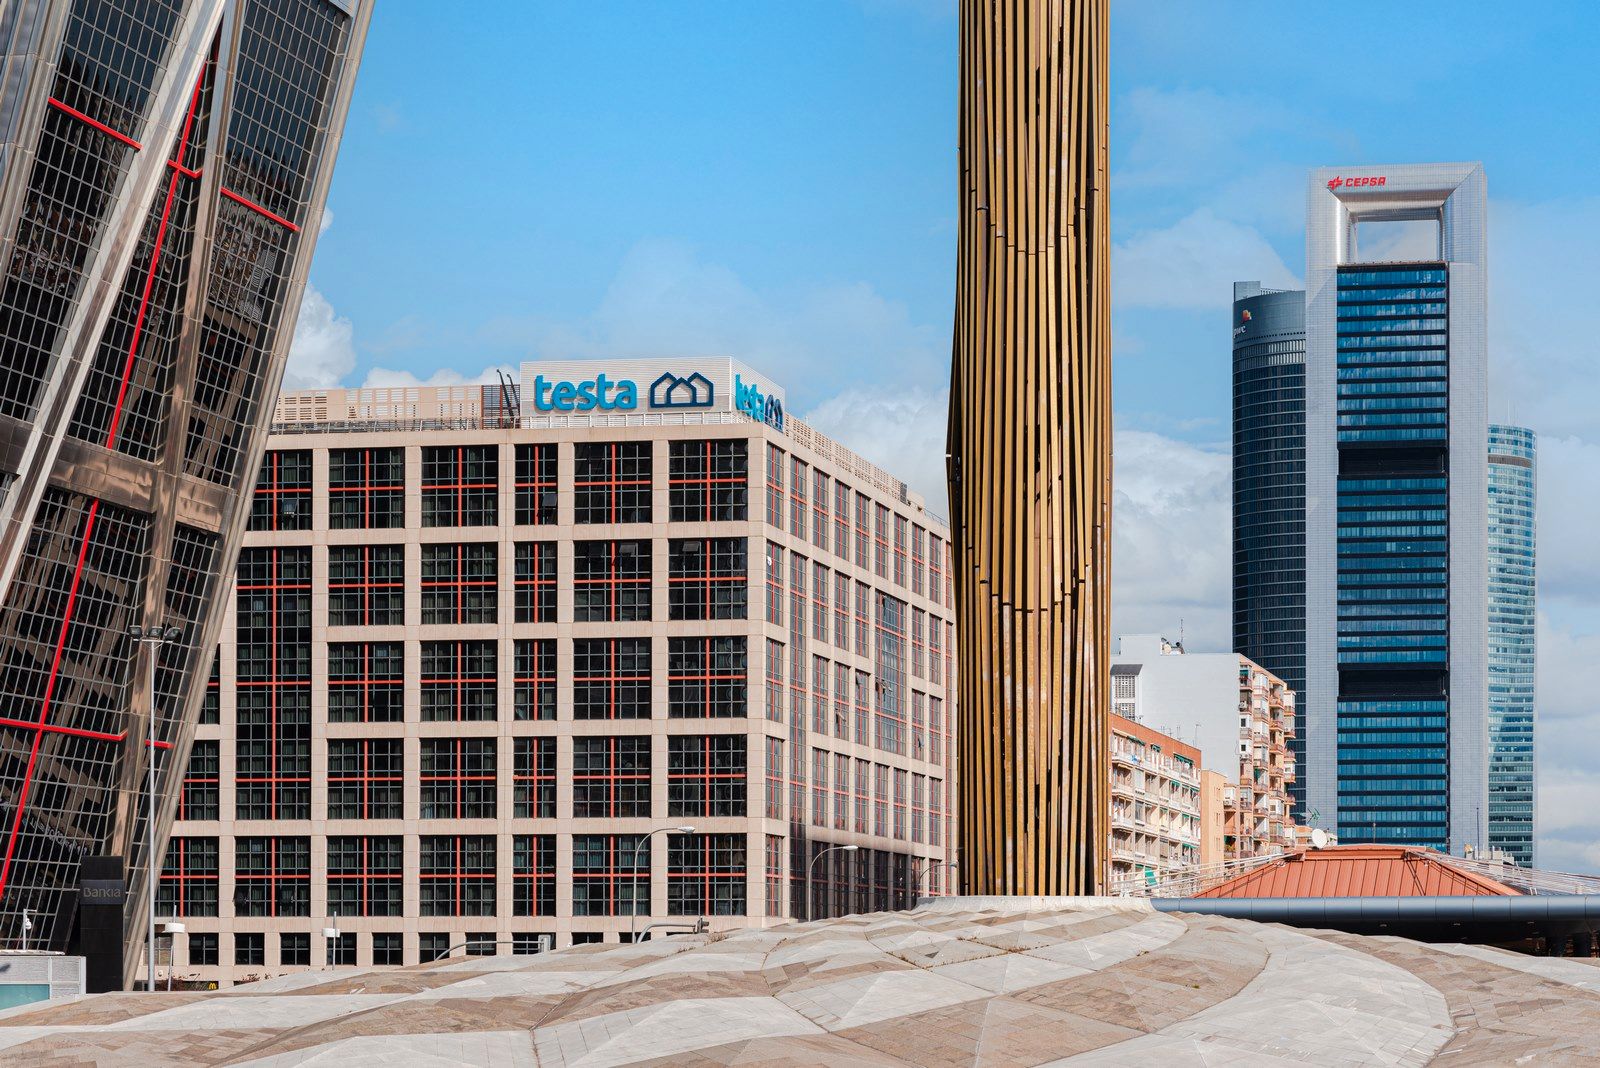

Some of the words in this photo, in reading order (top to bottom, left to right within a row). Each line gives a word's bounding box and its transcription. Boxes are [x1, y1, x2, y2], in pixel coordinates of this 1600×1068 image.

[1345, 176, 1386, 187] CEPSA
[535, 373, 637, 411] testa
[83, 887, 121, 898] Bankia
